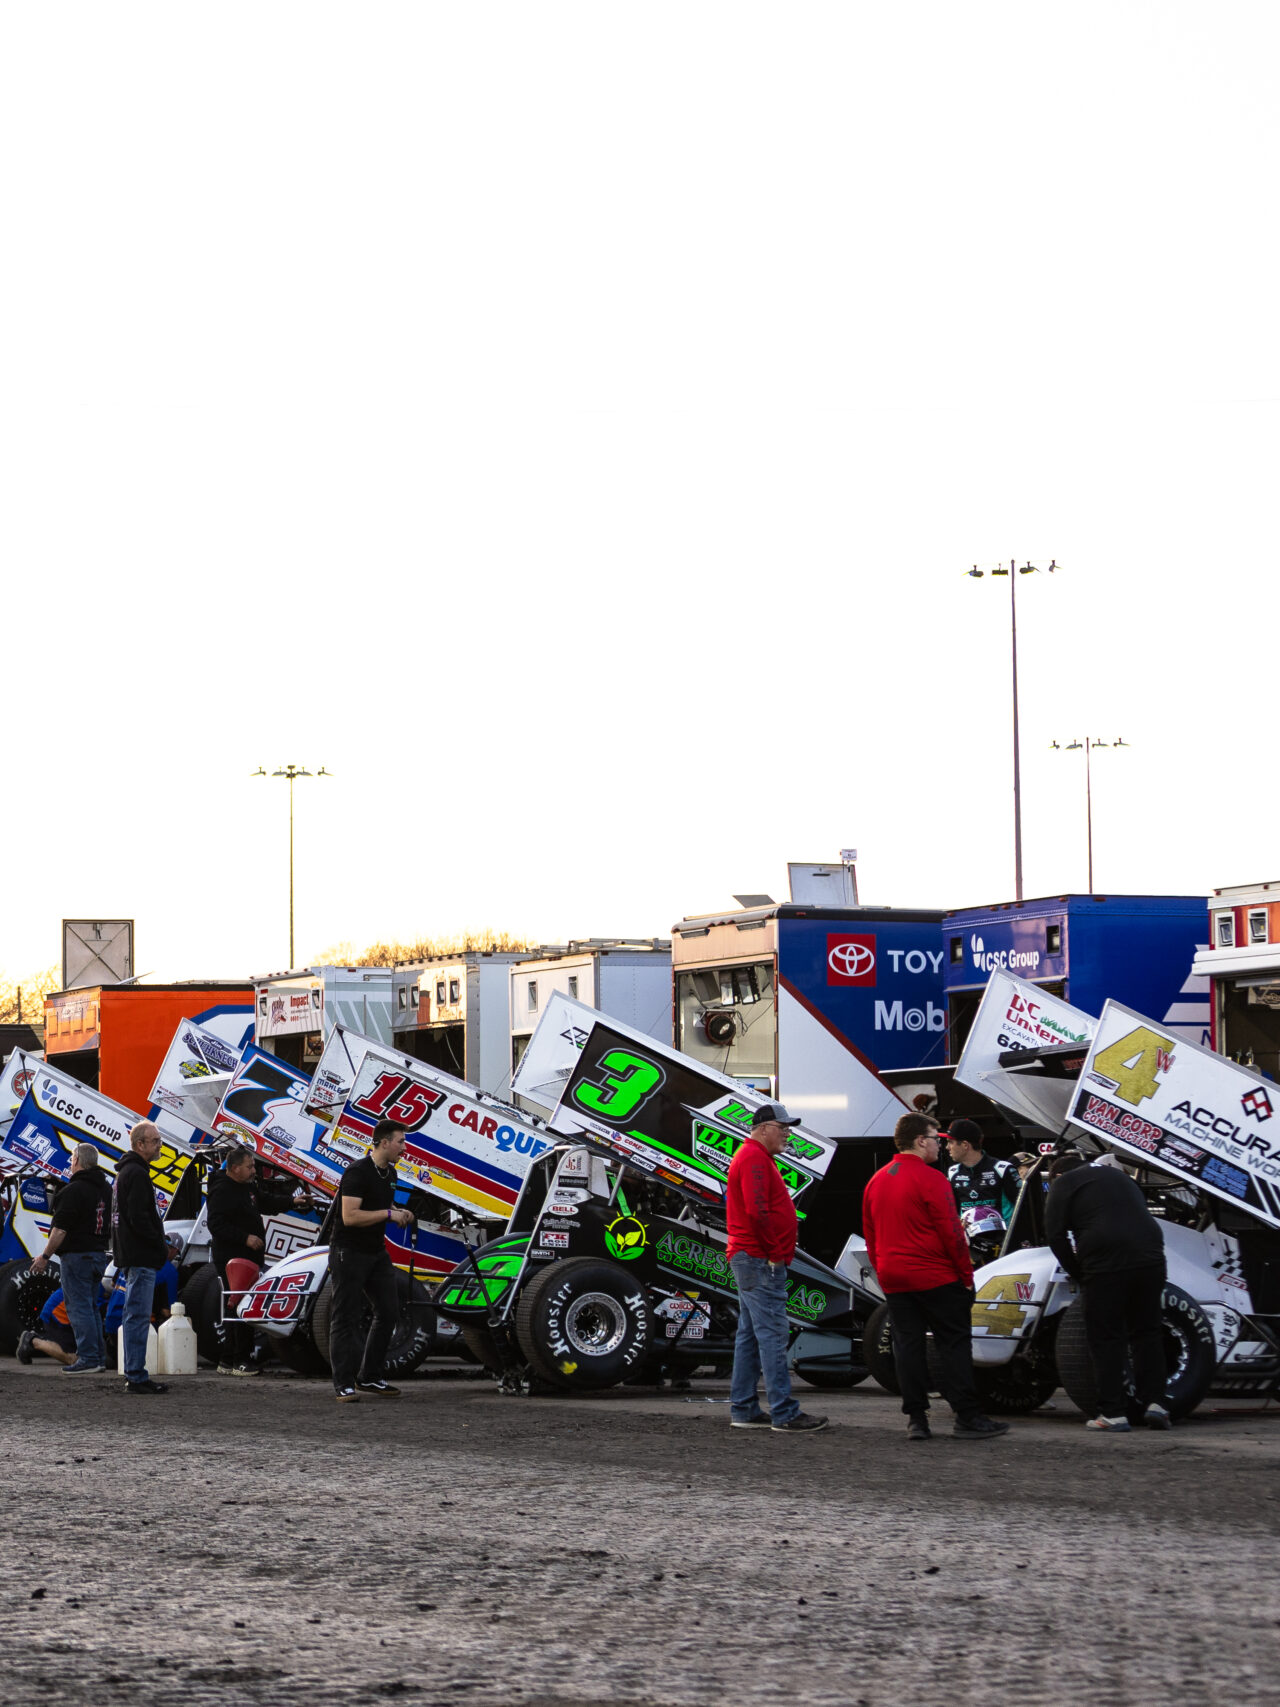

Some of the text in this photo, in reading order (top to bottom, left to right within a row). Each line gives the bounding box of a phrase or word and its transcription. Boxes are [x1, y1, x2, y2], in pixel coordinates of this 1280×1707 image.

[1008, 949, 1039, 970] Group
[317, 1077, 342, 1095] MAHLE
[353, 1071, 448, 1132] 15
[573, 1049, 665, 1122] 3
[56, 1099, 122, 1142] CSC Group
[448, 1103, 555, 1158] CARQUE
[1082, 1111, 1157, 1153] CONSTRUCTION
[1087, 1096, 1163, 1141] VAN GORP
[1164, 1113, 1245, 1159] MACHINE
[34, 1159, 64, 1177] ARP
[656, 1231, 729, 1275] ACRES
[240, 1271, 315, 1321] 15
[790, 1285, 826, 1313] AG
[547, 1281, 573, 1357] Hoosier
[623, 1291, 648, 1365] Hoosier
